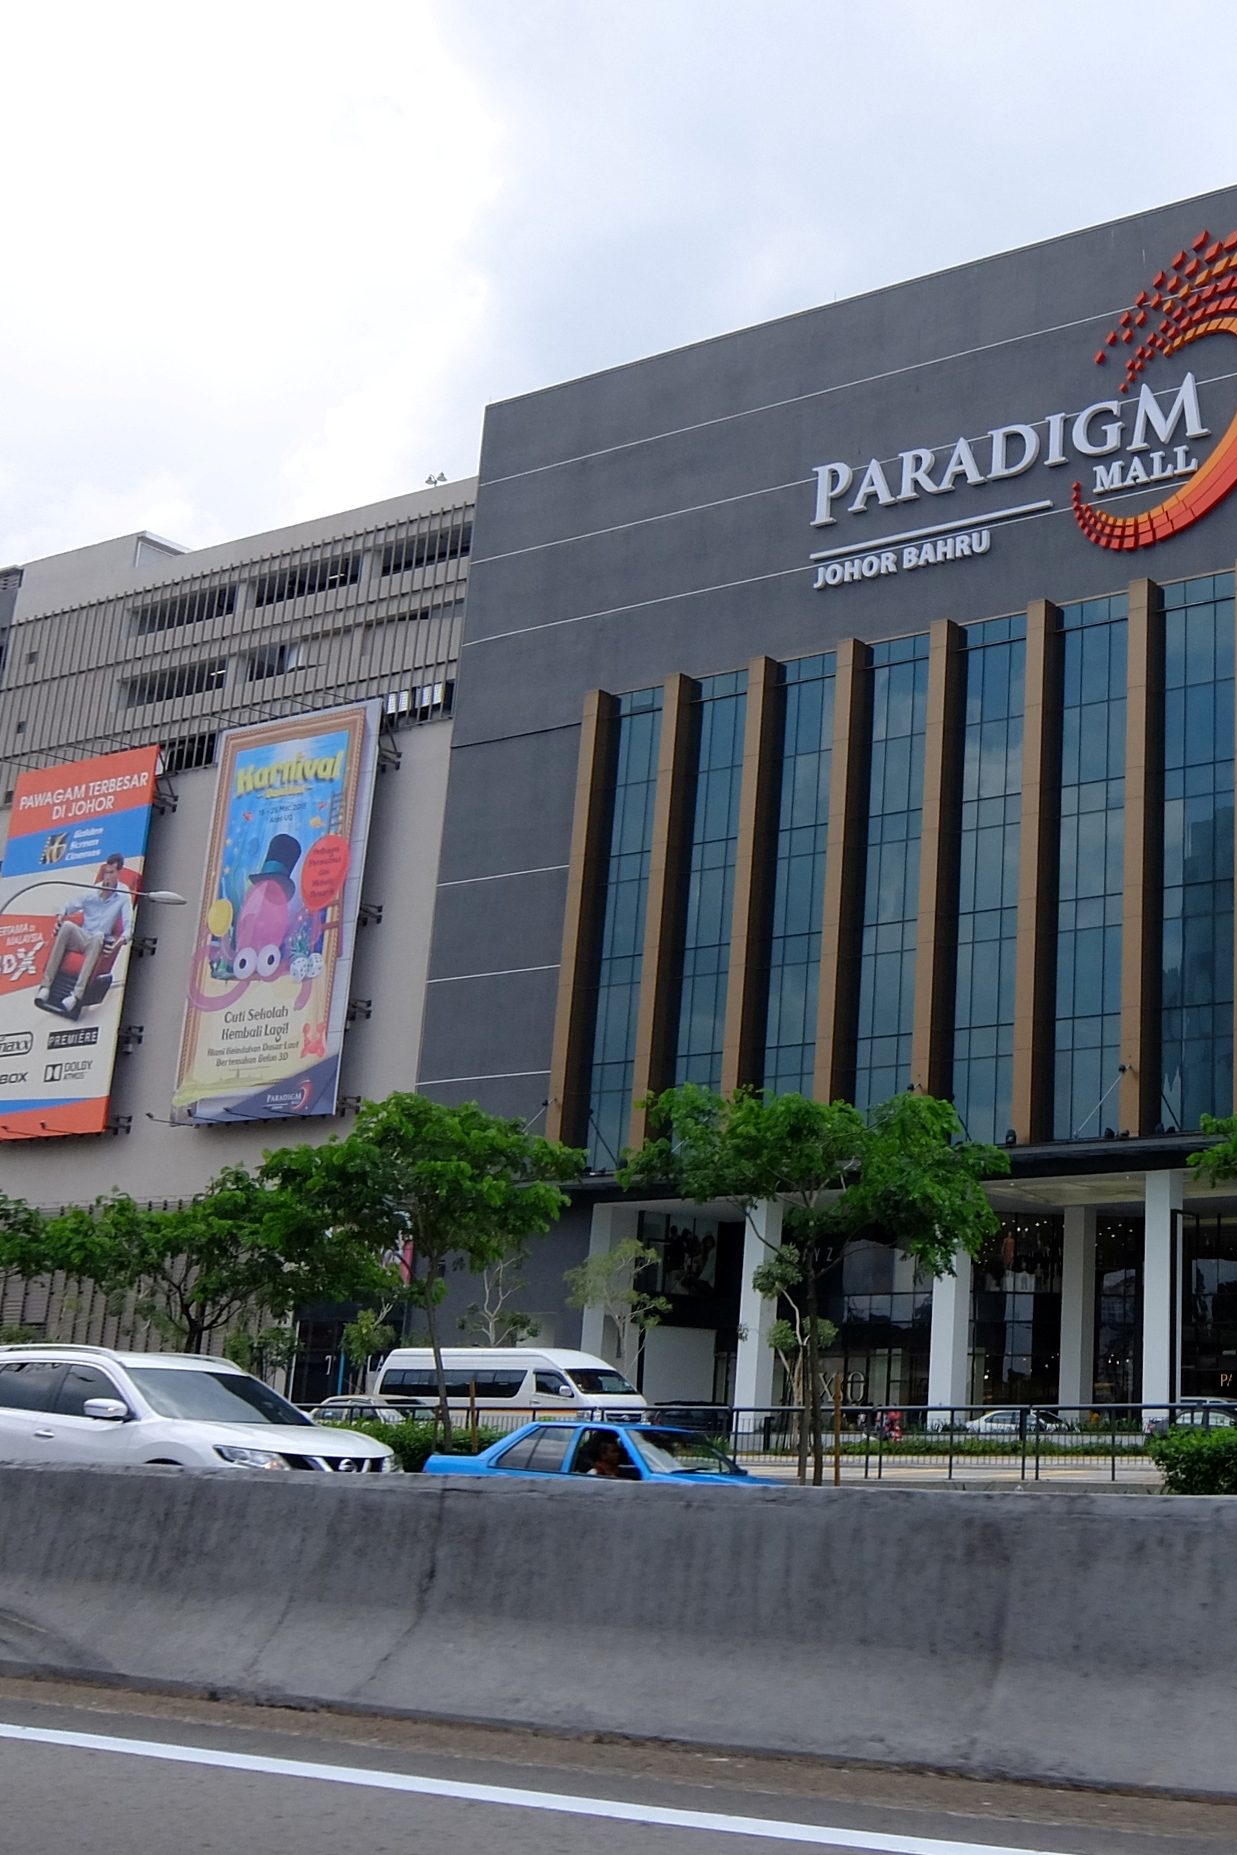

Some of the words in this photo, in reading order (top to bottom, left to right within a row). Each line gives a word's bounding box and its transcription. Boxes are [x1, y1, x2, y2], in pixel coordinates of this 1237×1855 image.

[809, 372, 1212, 528] PARADIGM
[1093, 445, 1199, 494] MALL
[813, 552, 898, 591] JOHOR
[902, 530, 992, 570] BAHRU
[19, 785, 86, 810] PAWAGAM
[89, 772, 149, 796] TERBESAR
[236, 751, 345, 799] Karnival
[52, 805, 66, 820] DI
[68, 796, 115, 818] JOHOR
[221, 1027, 263, 1040] Kembali
[264, 1022, 290, 1042] Lagi!
[224, 1010, 246, 1023] Cuti
[248, 1006, 289, 1021] Sekolah
[0, 1040, 29, 1053] axx
